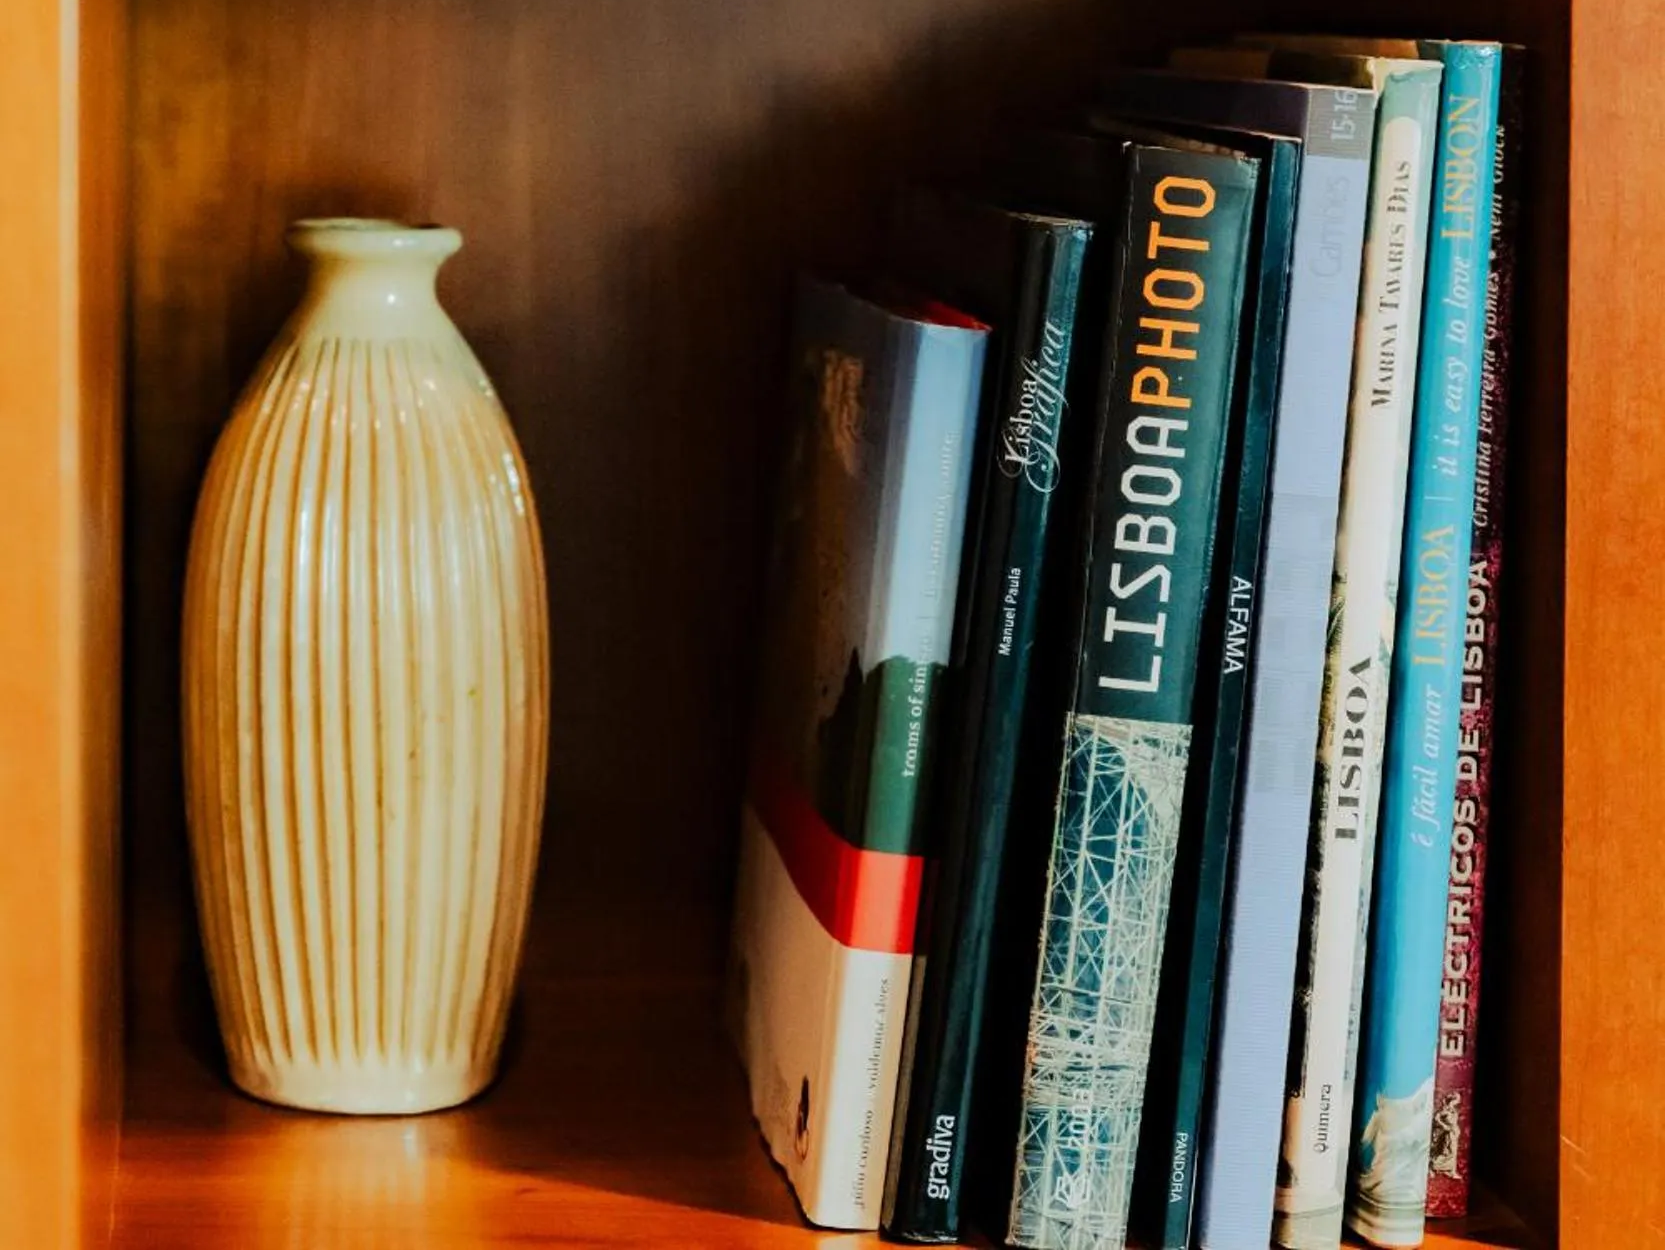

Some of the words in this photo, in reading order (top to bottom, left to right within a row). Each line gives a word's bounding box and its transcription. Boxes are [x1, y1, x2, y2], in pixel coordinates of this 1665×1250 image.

[1441, 94, 1481, 239] LISBON
[1443, 258, 1471, 310] love
[1445, 316, 1468, 343] to
[1441, 356, 1471, 413] easy
[1478, 348, 1498, 434] Ferreira
[996, 378, 1036, 479] Lisboa
[1433, 425, 1462, 449] is
[1431, 455, 1458, 476] it
[1472, 439, 1493, 528] Cristina
[1004, 567, 1021, 602] Paula
[1414, 526, 1454, 666] LISBOA
[999, 605, 1016, 655] Manuel
[1224, 575, 1253, 674] ALFAMA
[1461, 561, 1488, 711] LISBOA
[907, 694, 924, 718] of
[1422, 685, 1444, 761] amar
[1335, 658, 1372, 840] LISBOA
[1456, 729, 1481, 782] DE
[1413, 766, 1441, 833] fácil
[1410, 830, 1433, 848] é
[1314, 1084, 1332, 1154] Quimera
[926, 1113, 957, 1201] gradiva
[1169, 1132, 1189, 1203] PANDORA
